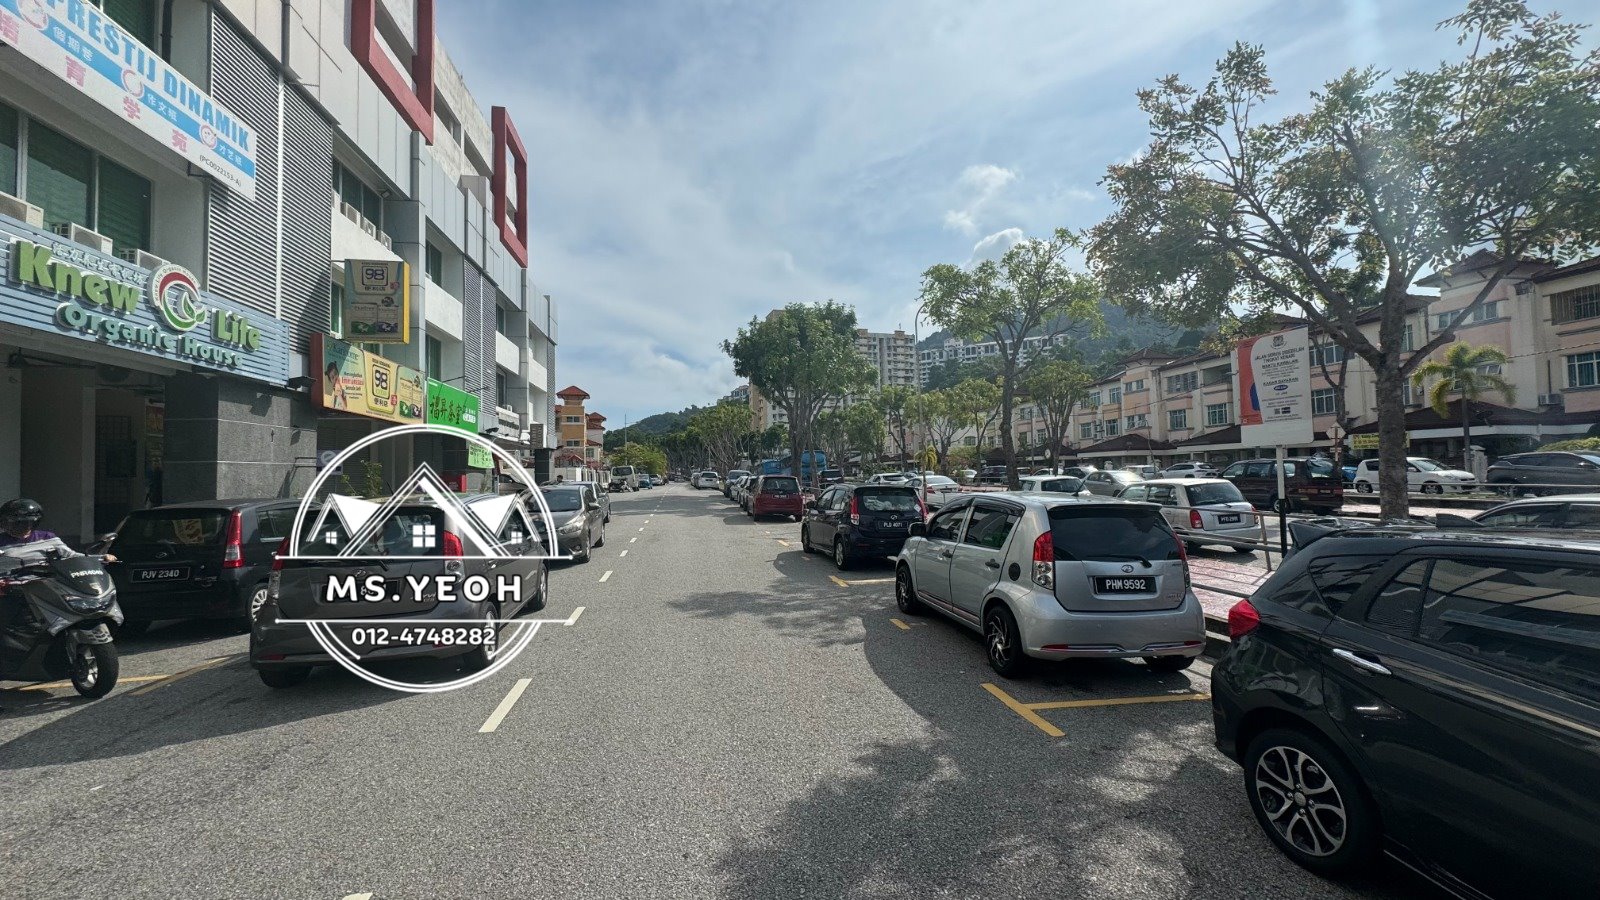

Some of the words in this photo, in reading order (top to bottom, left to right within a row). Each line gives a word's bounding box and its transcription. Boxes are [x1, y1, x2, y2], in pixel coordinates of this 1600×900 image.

[47, 0, 156, 82] RESTIJ
[164, 69, 249, 152] DINAMIK
[16, 240, 141, 314] Knew
[214, 307, 261, 351] Life
[63, 302, 176, 350] Organic
[184, 334, 243, 368] House
[141, 571, 156, 579] PJV
[158, 569, 180, 578] 2340
